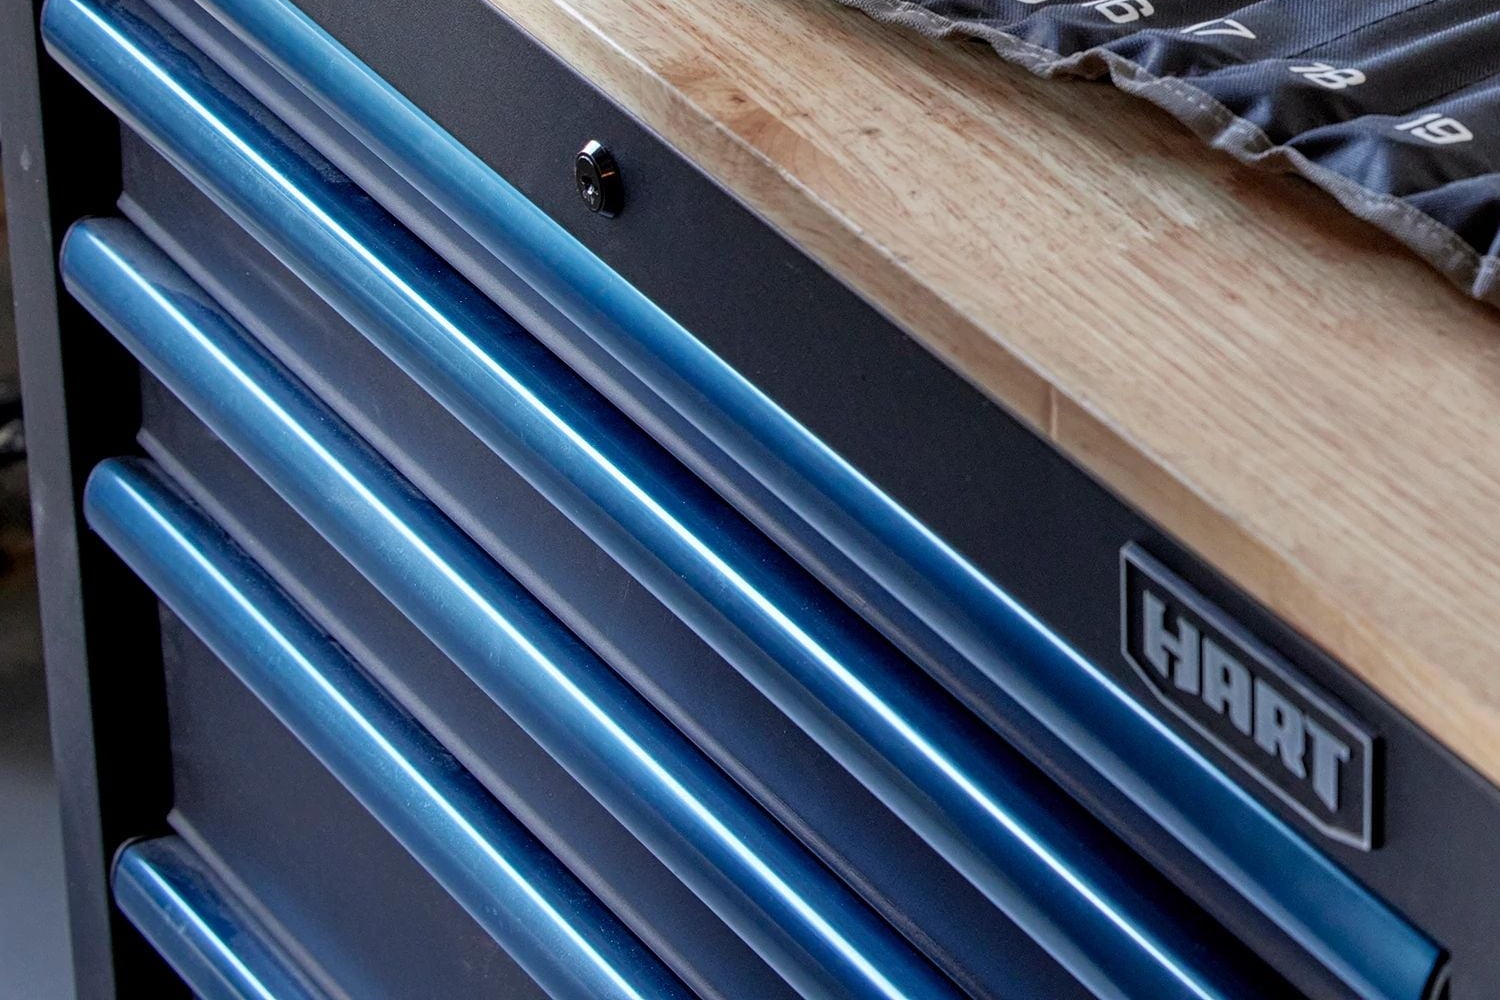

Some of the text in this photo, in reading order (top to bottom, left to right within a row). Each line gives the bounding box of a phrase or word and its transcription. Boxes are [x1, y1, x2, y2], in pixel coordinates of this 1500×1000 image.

[1289, 62, 1367, 90] 18
[1394, 112, 1474, 145] 19
[1143, 589, 1351, 813] HART
